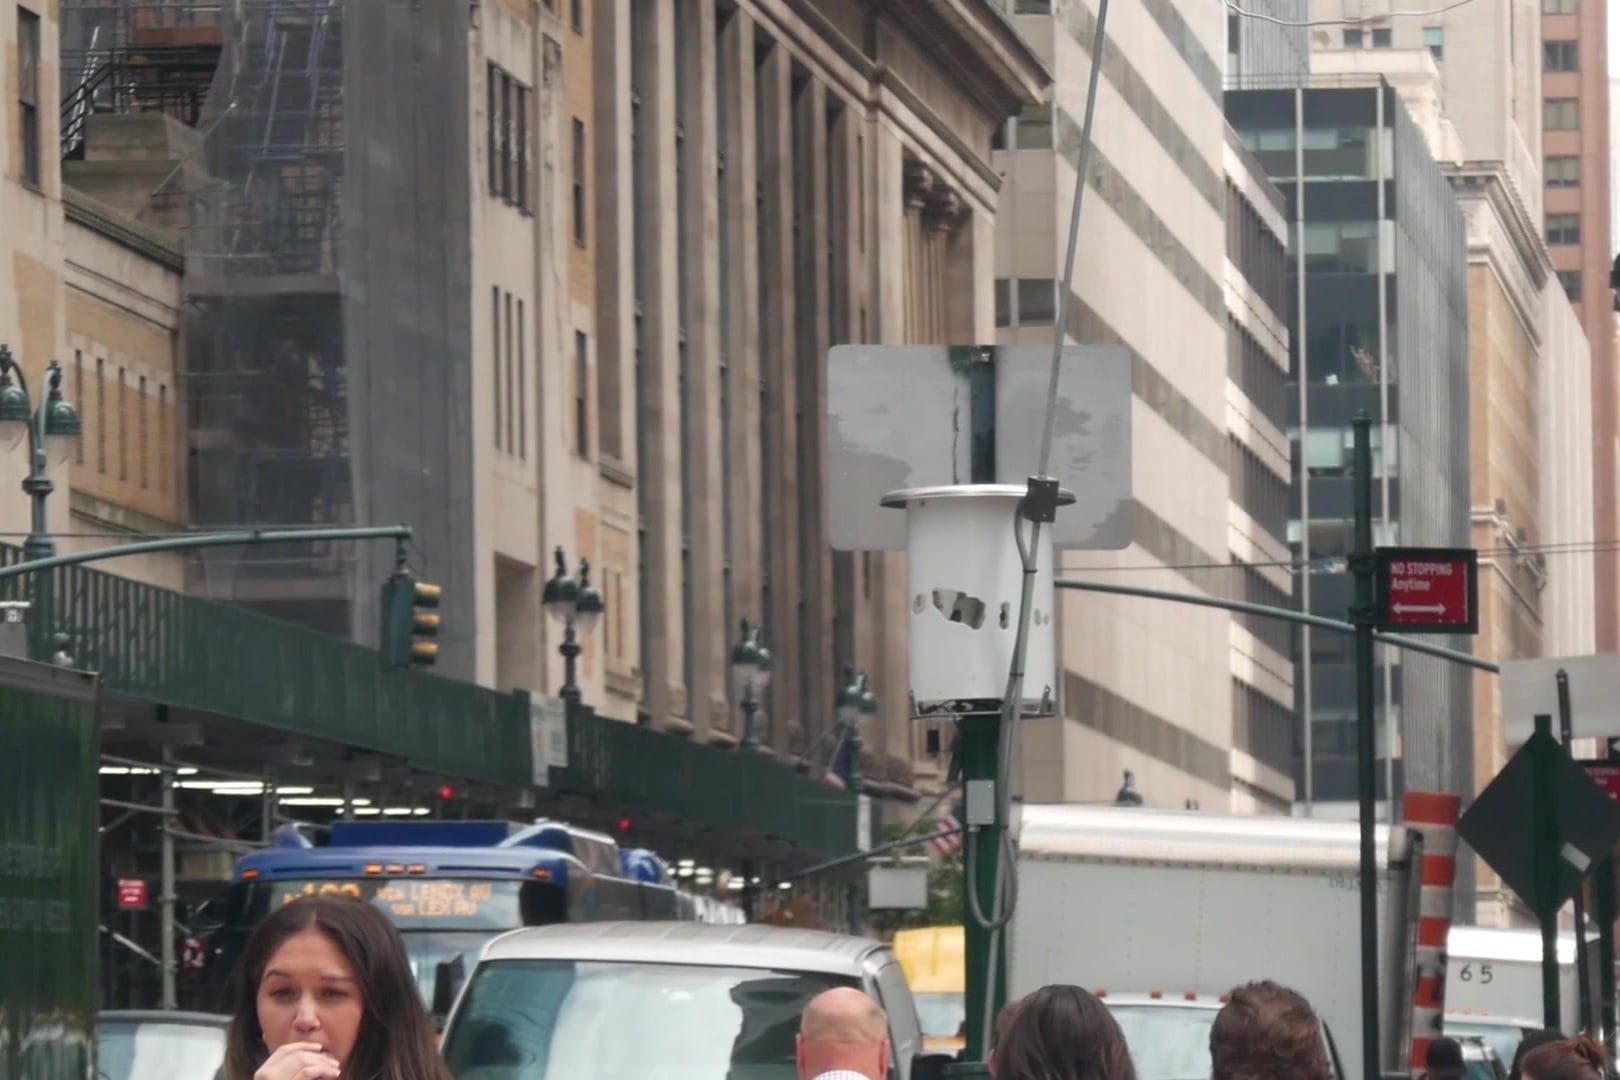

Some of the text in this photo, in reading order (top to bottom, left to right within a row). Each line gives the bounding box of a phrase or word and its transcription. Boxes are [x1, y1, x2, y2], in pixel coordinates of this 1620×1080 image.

[1391, 561, 1453, 576] NO STOPPING
[1391, 577, 1430, 593] Anytime
